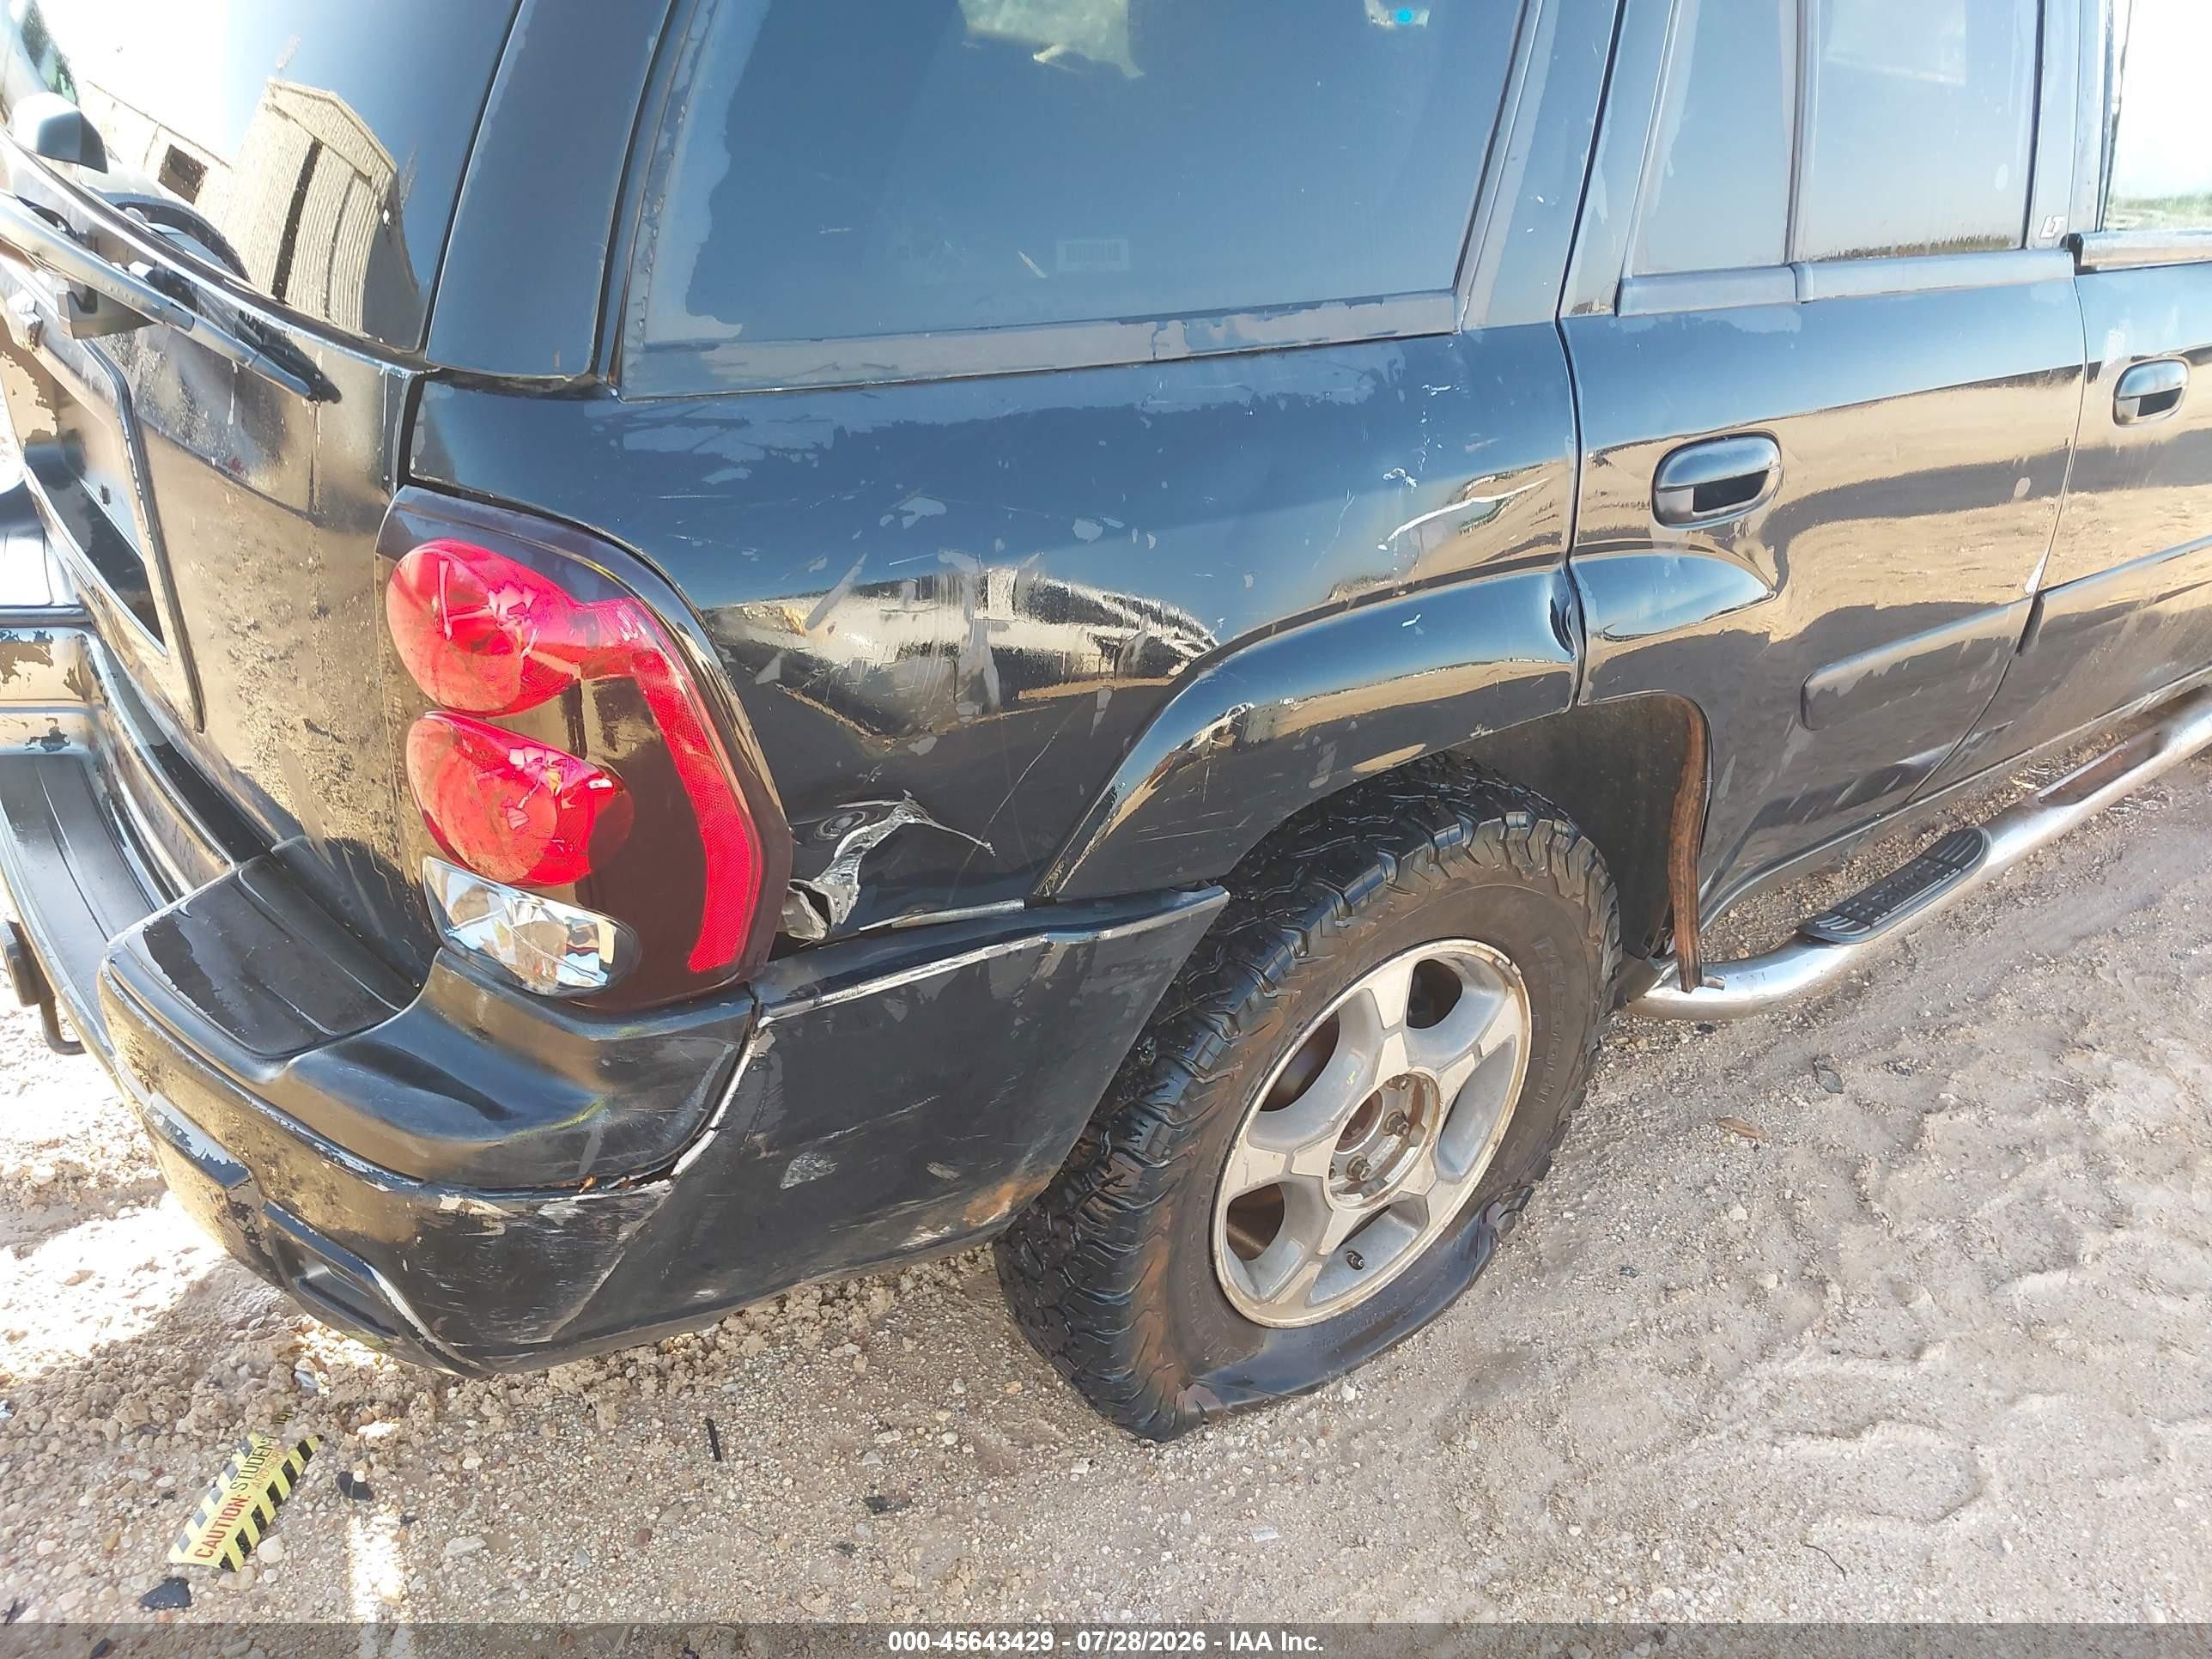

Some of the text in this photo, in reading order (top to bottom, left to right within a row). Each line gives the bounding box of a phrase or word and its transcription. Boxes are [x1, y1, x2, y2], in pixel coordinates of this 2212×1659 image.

[2039, 215, 2067, 239] LT
[252, 1468, 270, 1489] AND
[194, 1493, 252, 1559] CAUTION:
